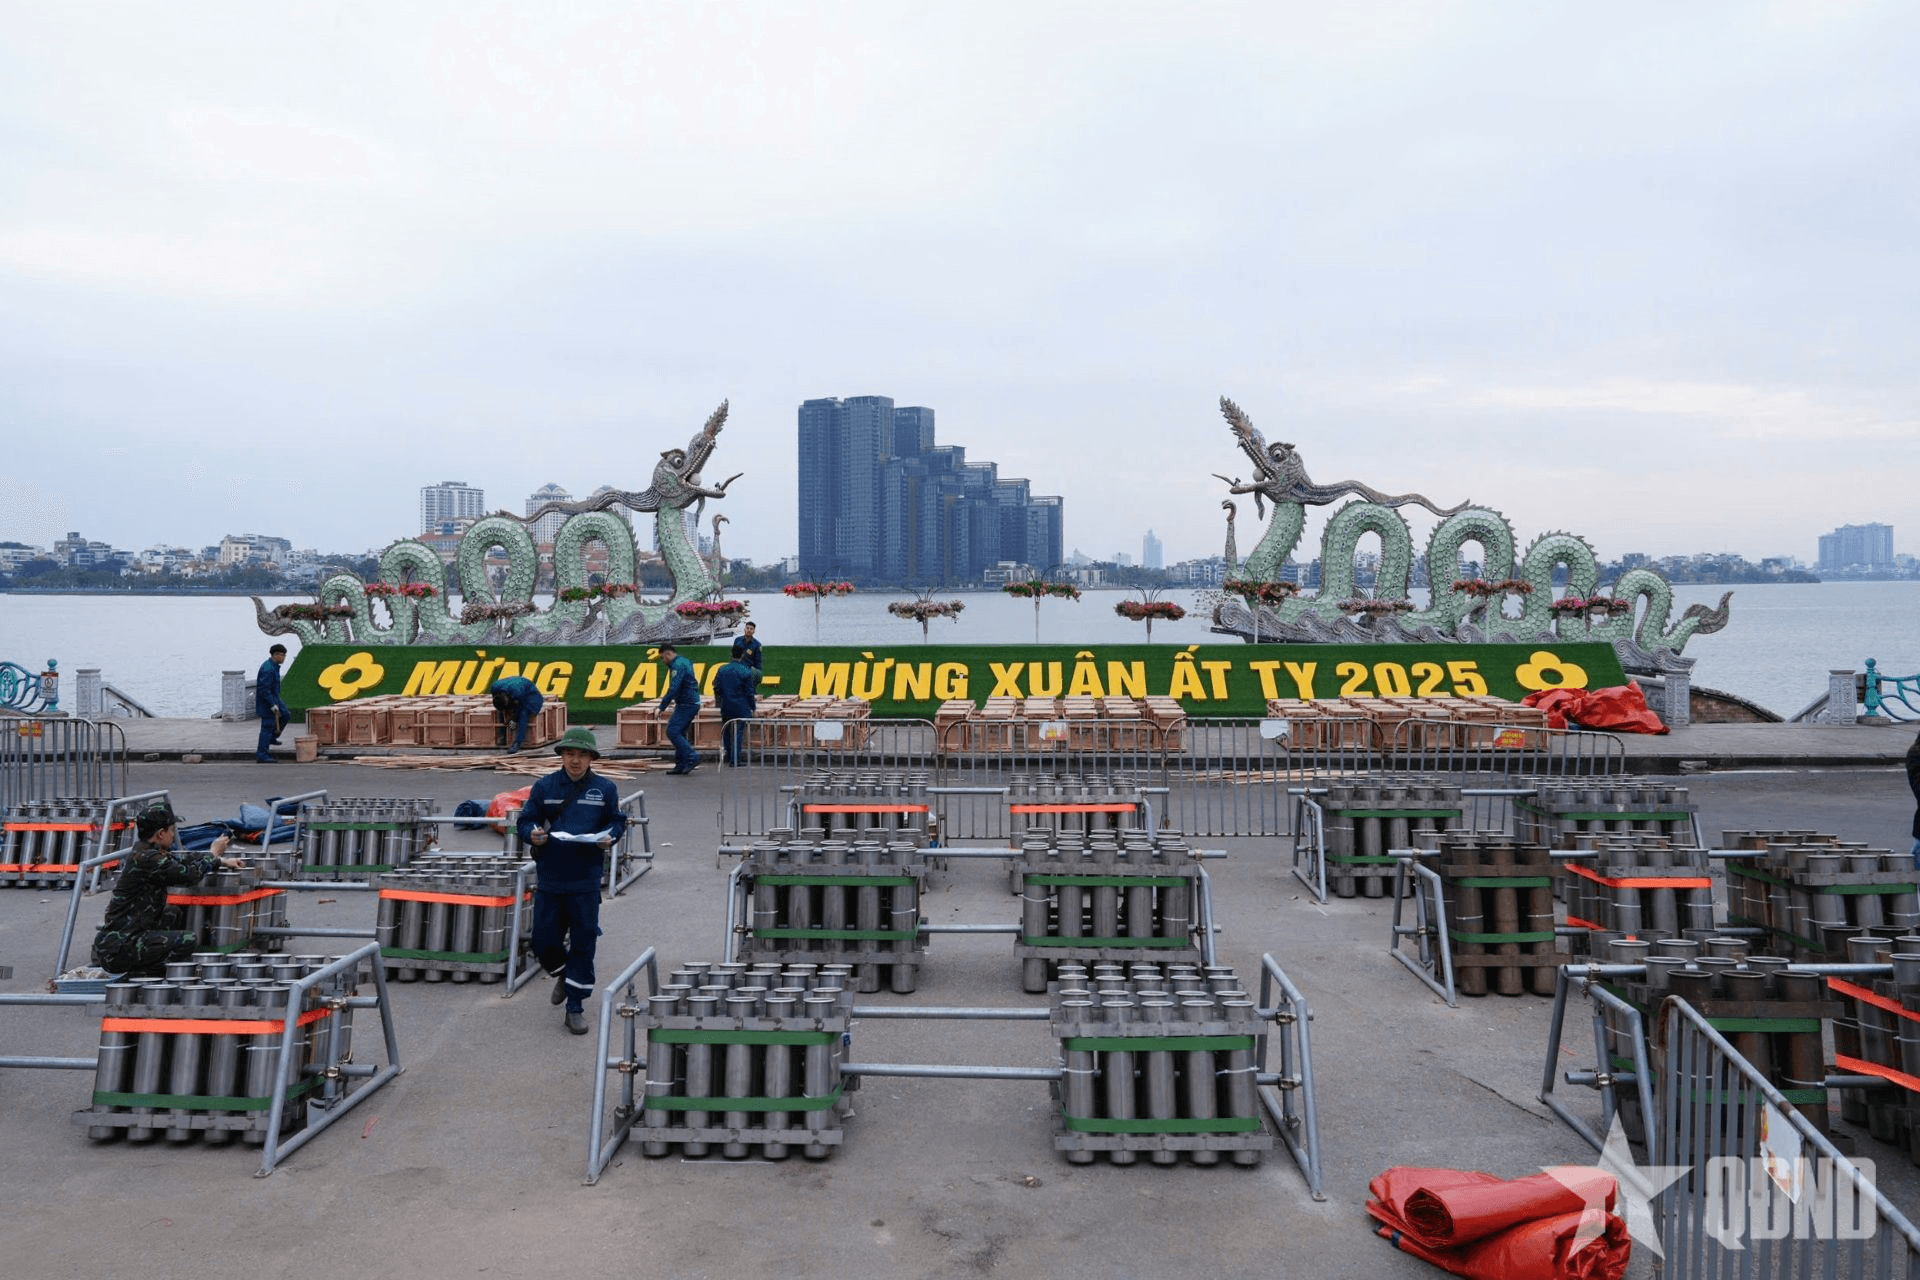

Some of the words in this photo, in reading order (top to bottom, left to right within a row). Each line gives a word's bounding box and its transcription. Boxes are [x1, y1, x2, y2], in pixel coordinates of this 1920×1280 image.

[583, 647, 726, 699] ĐẢ
[798, 651, 969, 701] MỪNG
[990, 650, 1148, 699] XUÂN
[1169, 644, 1232, 700] ẤT
[1335, 661, 1489, 698] 2025
